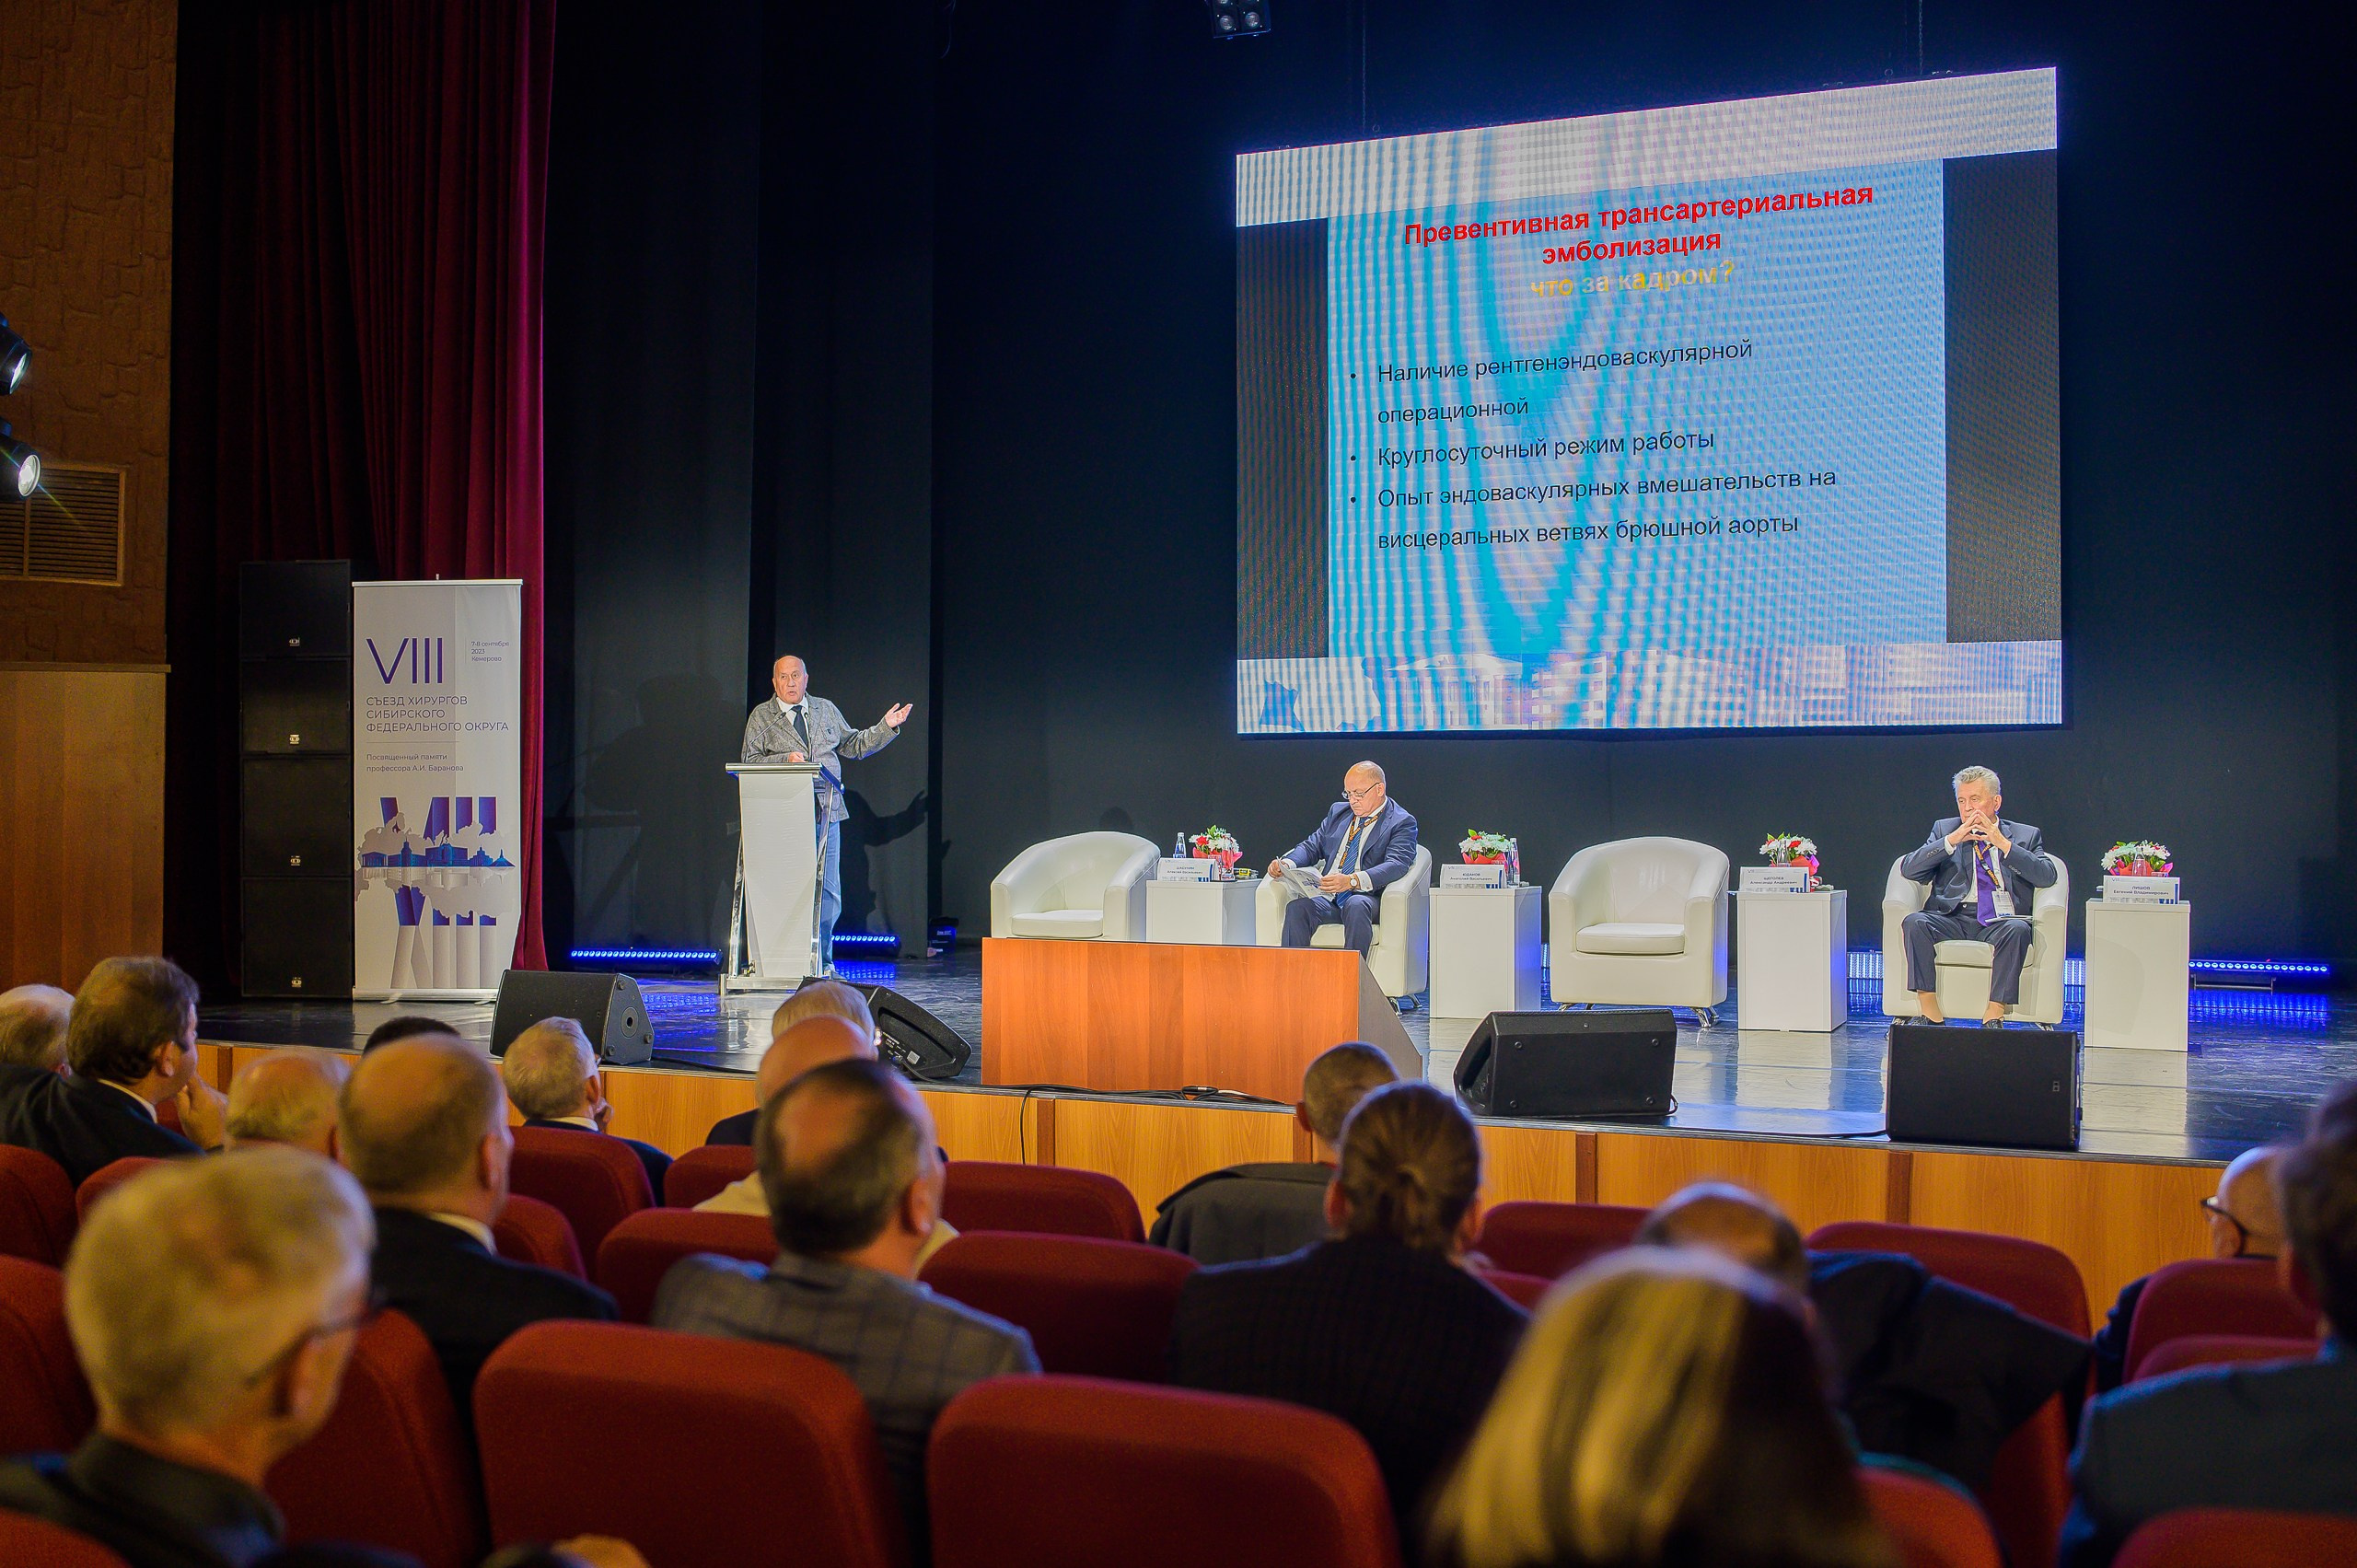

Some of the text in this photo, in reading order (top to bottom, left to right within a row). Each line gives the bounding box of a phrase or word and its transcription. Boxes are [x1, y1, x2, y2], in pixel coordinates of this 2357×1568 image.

[1404, 186, 1874, 248] Превентивная трансартериальная
[1542, 233, 1722, 265] эмболизация
[1530, 260, 1735, 297] что за кадром?
[1377, 338, 1752, 383] Наличие рентгенэндоваскулярной
[1377, 396, 1529, 426] операционной
[1377, 430, 1714, 470] Круглосуточный режим работы
[1377, 470, 1837, 507] Опыт эндоваскулярных вмешательств на
[1377, 516, 1798, 551] висцеральных ветвях брюшной аорты
[366, 637, 443, 685] VIII
[366, 695, 468, 706] СЪЕЗД ХИРУРГОВ
[366, 709, 446, 719] СИБИРСКОГО
[366, 721, 509, 733] ФЕДЕРАЛЬНОГО ОКРУГА
[366, 753, 419, 761] Посвященный
